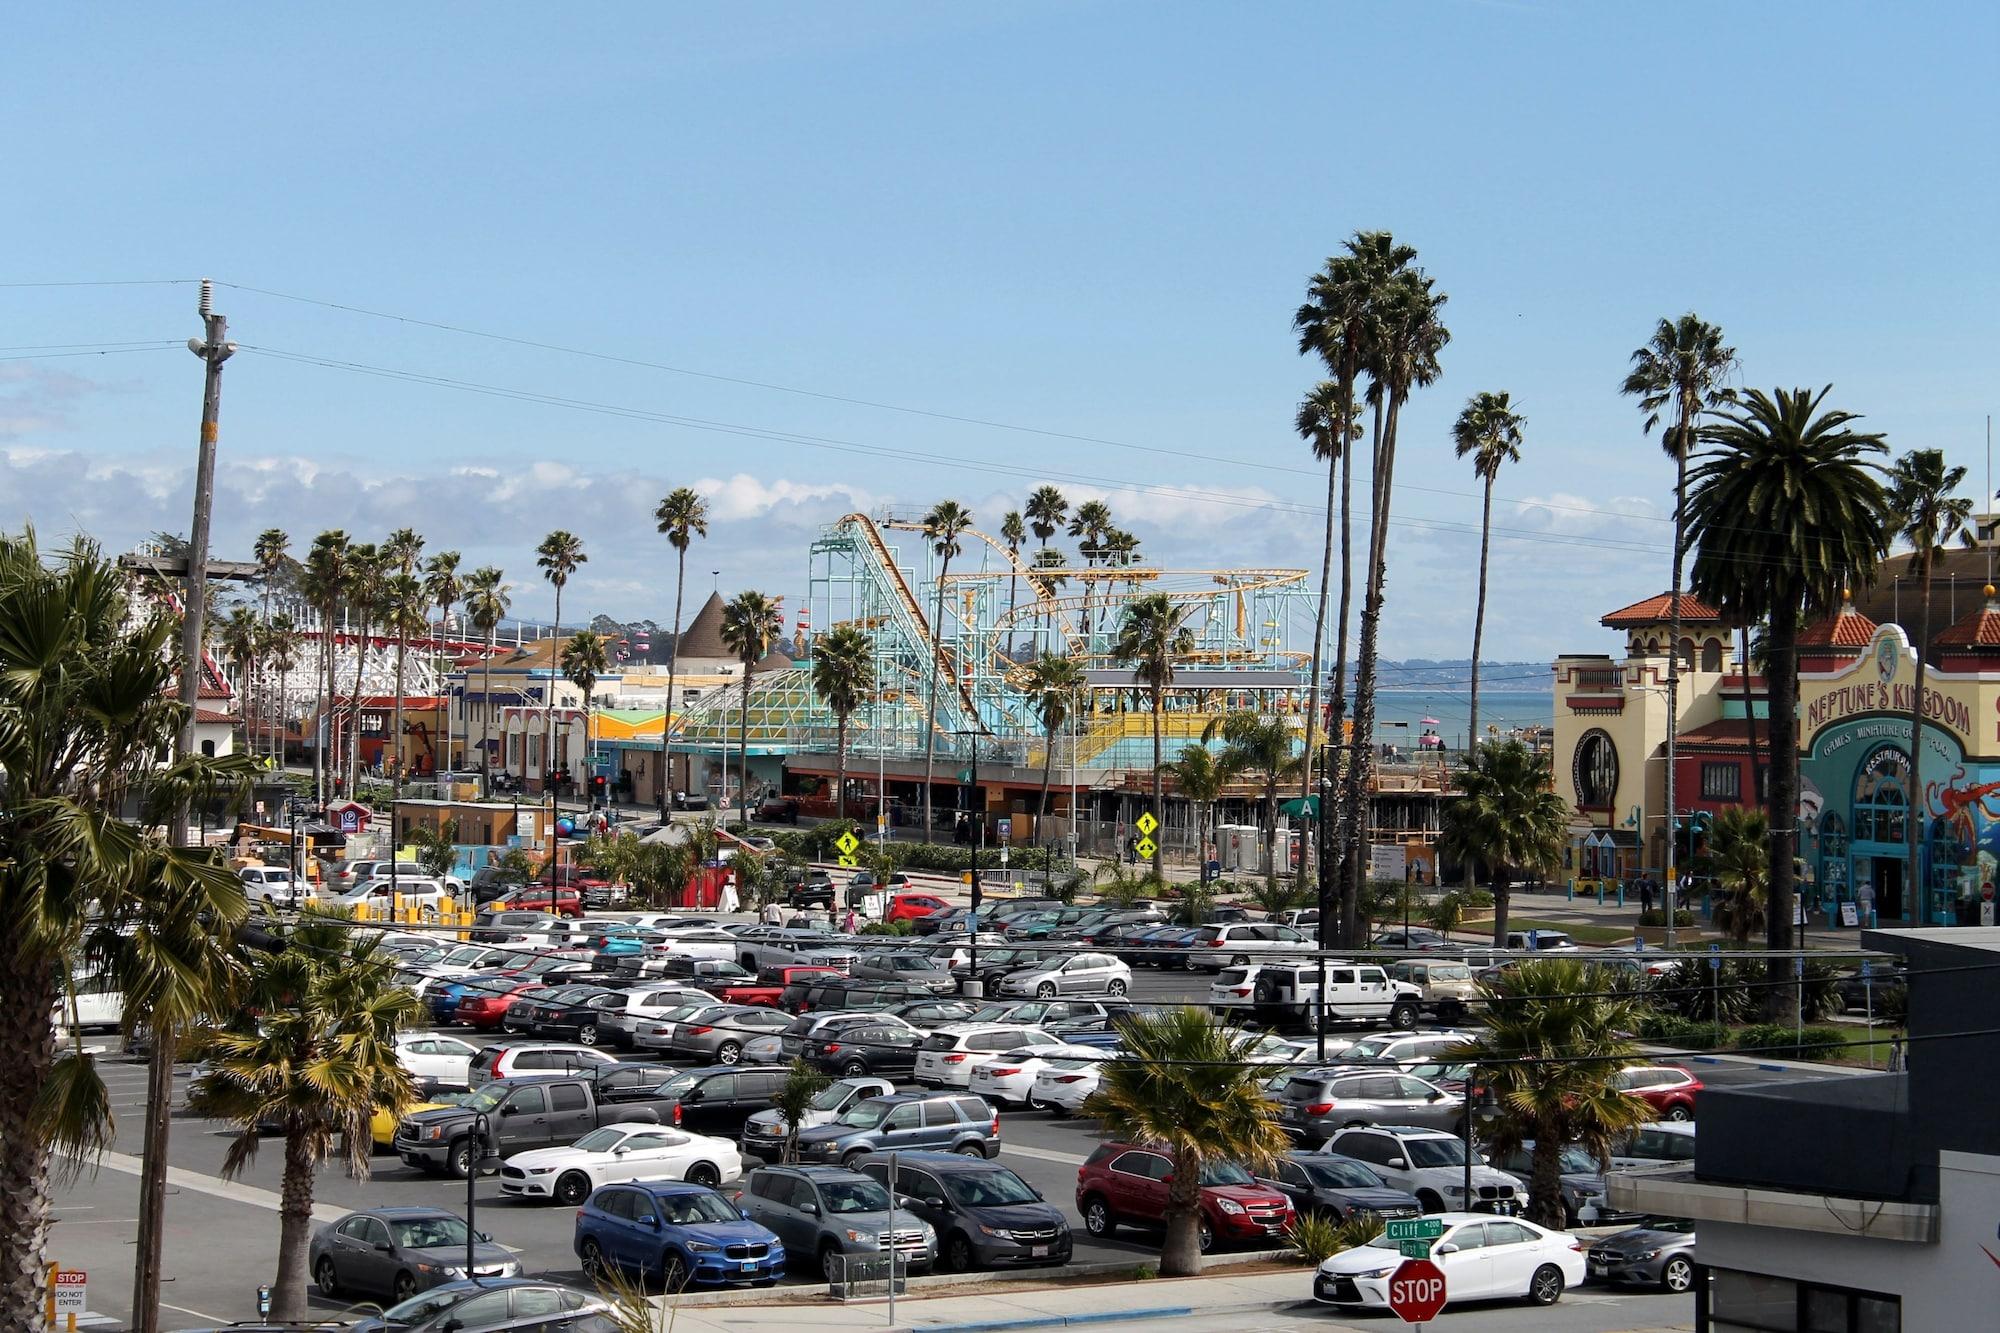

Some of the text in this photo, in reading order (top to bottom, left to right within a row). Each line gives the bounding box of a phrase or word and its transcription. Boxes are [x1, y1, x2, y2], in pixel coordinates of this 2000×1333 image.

[1807, 681, 1890, 730] NEPTUNE'S
[1823, 731, 1852, 758] GAMES
[1856, 724, 1900, 740] MINIATURE
[1865, 748, 1912, 776] RESTAURAN
[964, 771, 971, 782] A
[1301, 800, 1314, 815] A
[1391, 1223, 1418, 1237] Cliff
[1430, 1228, 1437, 1236] St
[58, 1273, 85, 1282] STOP
[1393, 1278, 1443, 1304] STOP
